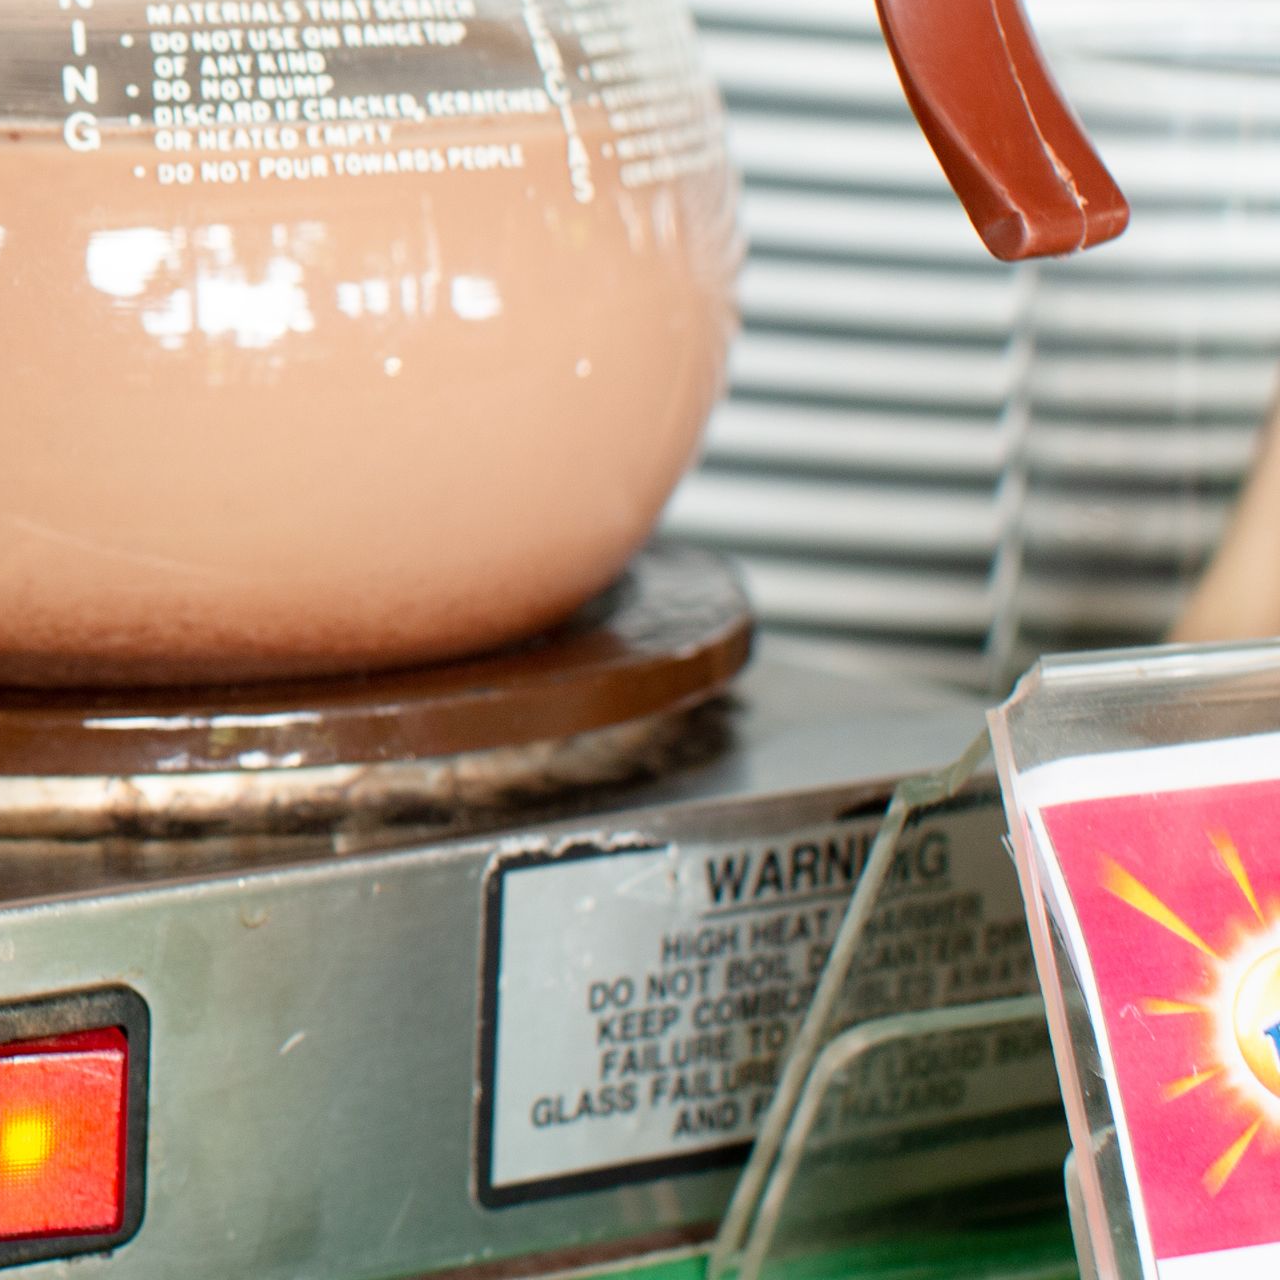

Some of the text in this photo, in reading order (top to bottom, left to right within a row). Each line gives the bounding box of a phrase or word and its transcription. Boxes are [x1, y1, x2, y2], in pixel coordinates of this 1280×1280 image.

[145, 0, 303, 25] MATERIALS
[149, 31, 190, 54] DO
[191, 29, 246, 52] NOT
[247, 27, 299, 51] USE
[301, 25, 341, 48] ON
[152, 50, 328, 79] OF ANY KIND
[151, 74, 335, 102] DO NOT BUMP
[152, 101, 273, 127] DISCARD
[154, 128, 194, 152] OR
[197, 125, 301, 151] HEATED
[156, 163, 195, 185] DO
[200, 160, 251, 184] NOT
[258, 154, 329, 180] POUR
[330, 147, 446, 177] TOWARDS
[659, 926, 740, 963] HIGH
[748, 911, 831, 949] HEAT
[587, 976, 636, 1013] DO
[646, 964, 712, 1001] NOT
[726, 952, 796, 990] BOIL
[805, 925, 976, 978] DCANTER
[596, 1006, 681, 1046] KEEP
[600, 1020, 789, 1081] FAILURE TO
[530, 1083, 639, 1130] GLASS
[672, 1100, 742, 1142] AND
